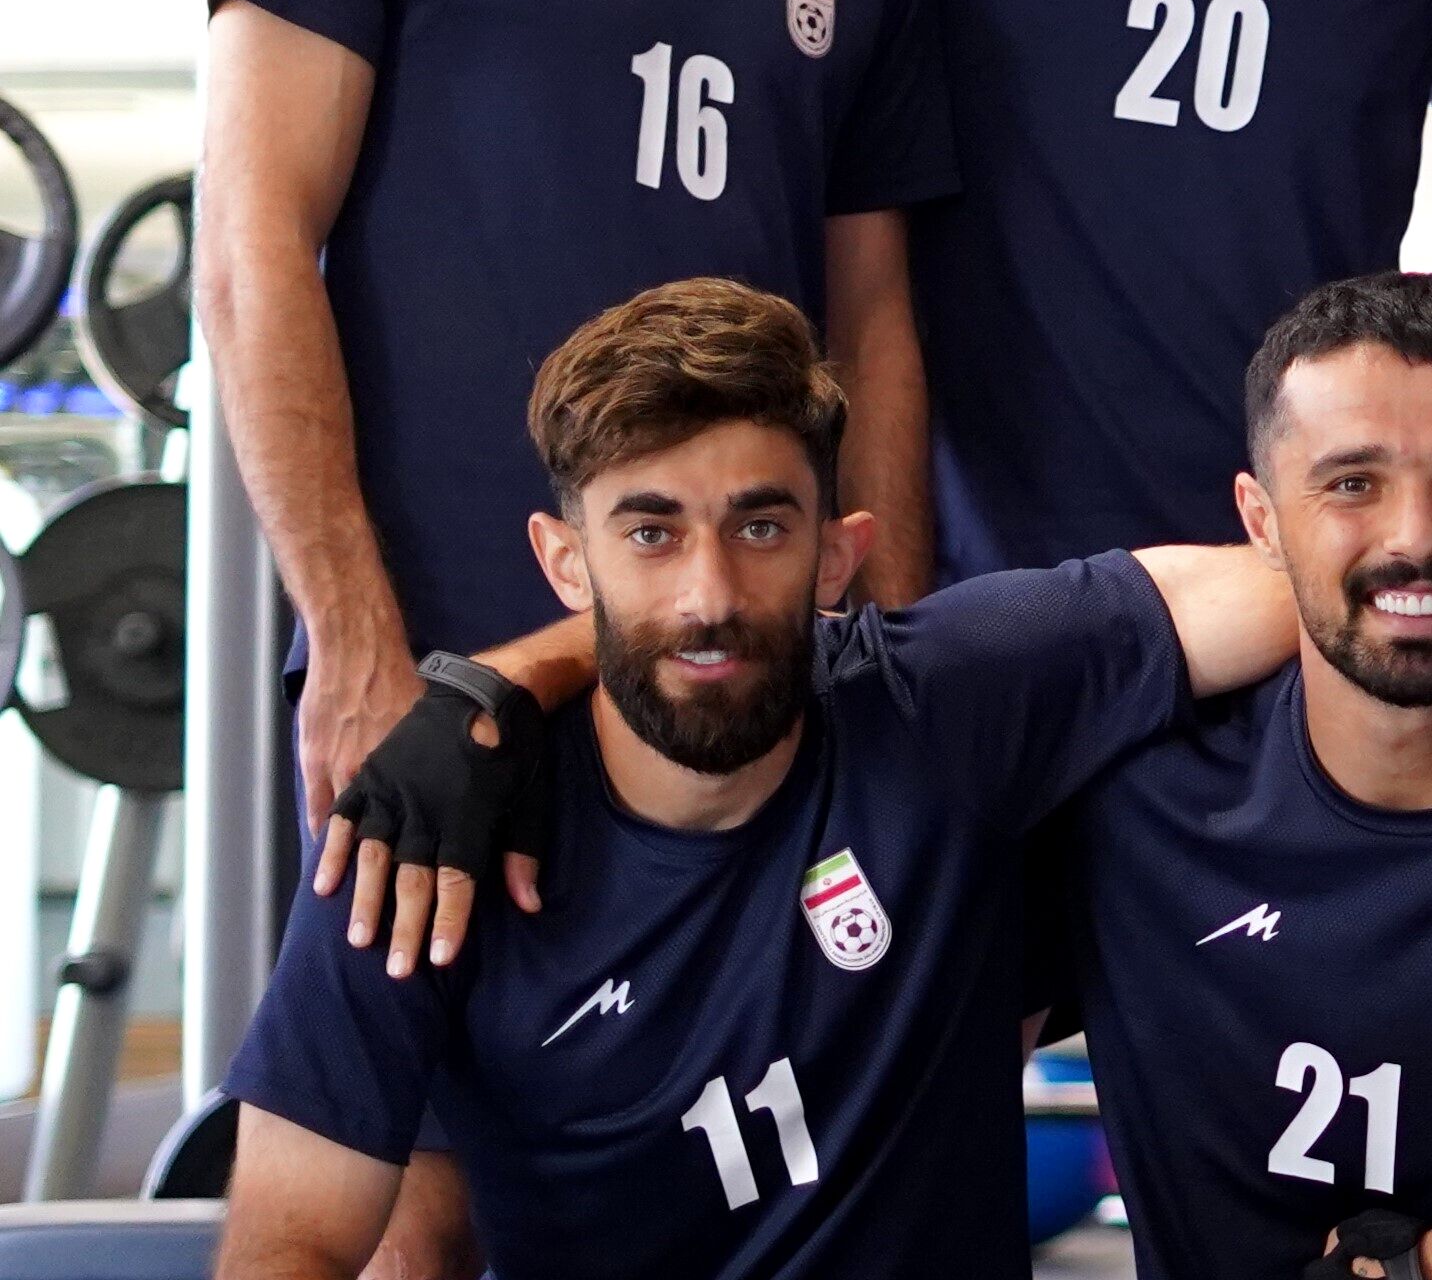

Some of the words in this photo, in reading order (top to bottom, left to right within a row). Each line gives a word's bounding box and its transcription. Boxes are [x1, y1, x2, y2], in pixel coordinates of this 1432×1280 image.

[632, 42, 734, 200] 16
[682, 1058, 818, 1209] 11
[1268, 1042, 1401, 1194] 21
